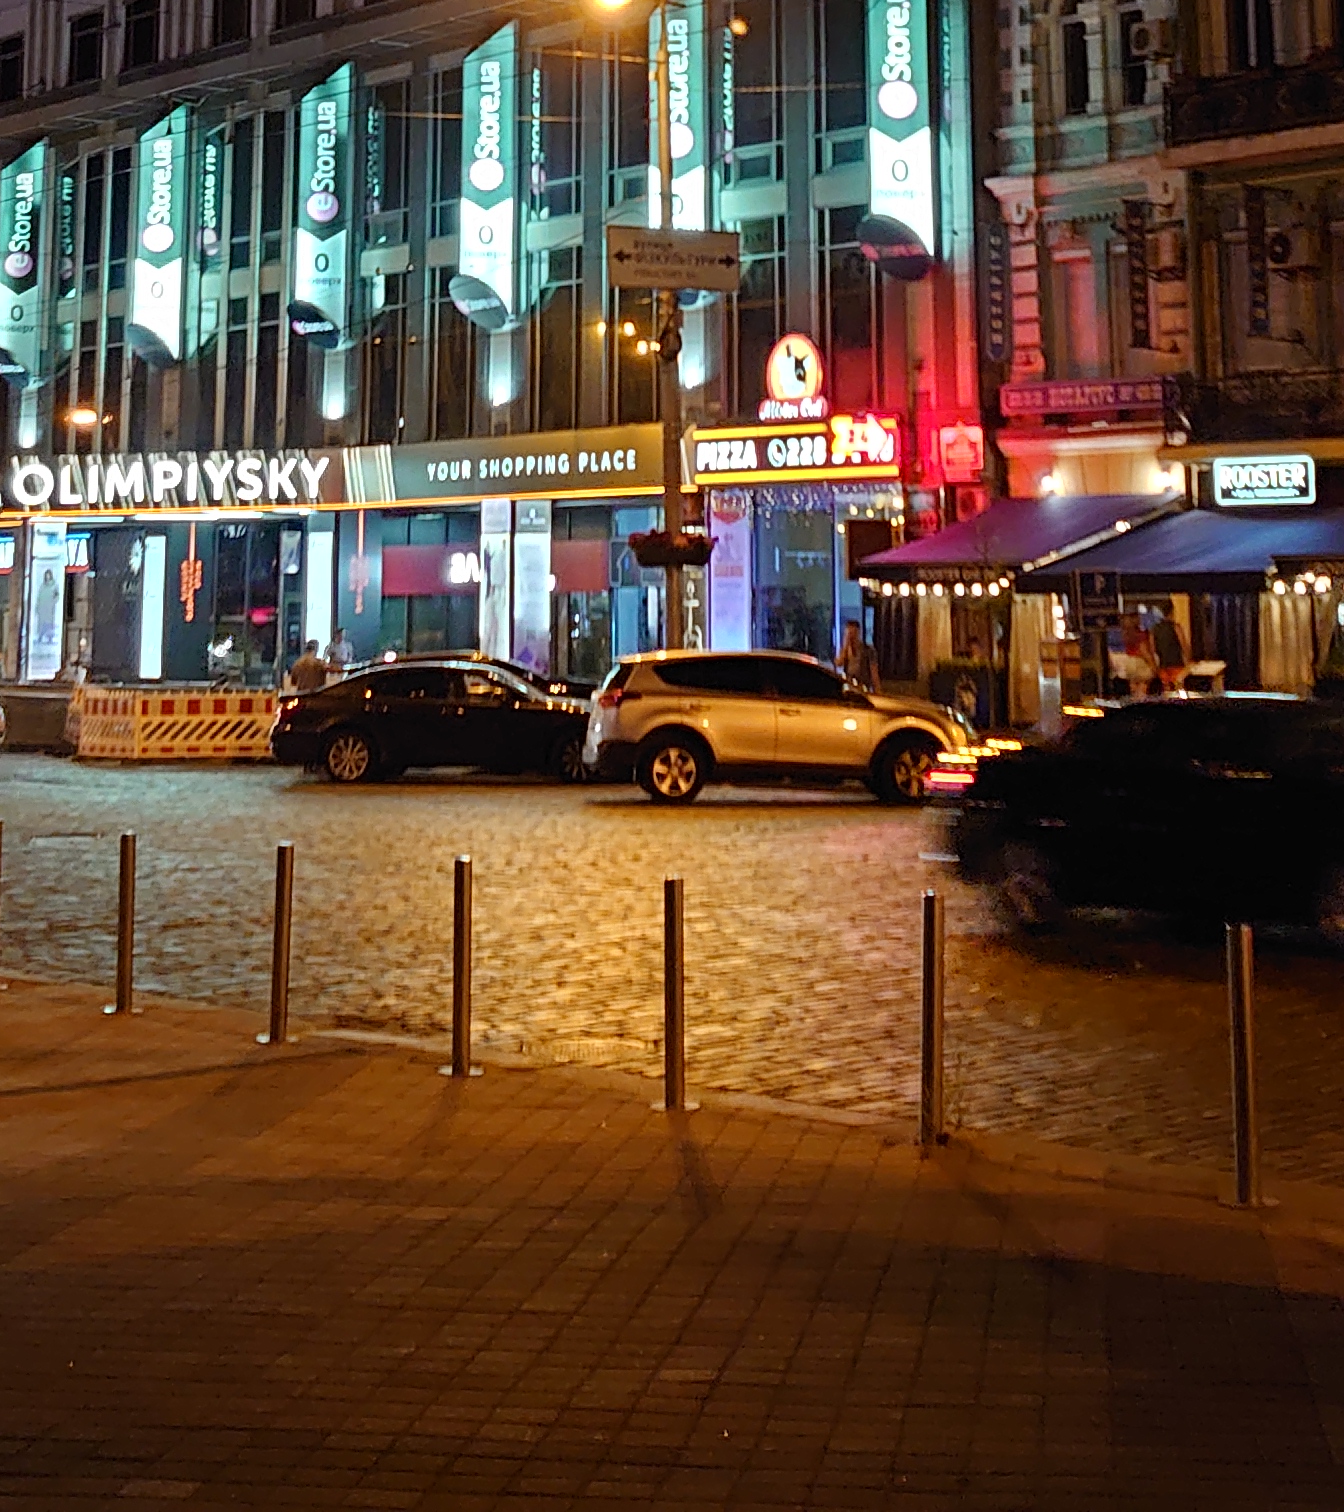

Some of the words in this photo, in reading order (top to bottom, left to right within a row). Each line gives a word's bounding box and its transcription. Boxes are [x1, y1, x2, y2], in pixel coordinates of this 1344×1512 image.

[469, 61, 504, 191] Store.ua
[667, 19, 694, 158] Store.ua
[141, 139, 174, 253] Store.ua
[306, 101, 339, 222] eStore.ua
[4, 172, 34, 277] eStore.ua
[12, 456, 330, 506] OLIMPIYSKY
[427, 458, 472, 482] YOUR
[479, 454, 570, 478] SHOPPING
[578, 449, 637, 473] PLACE
[697, 440, 757, 471] PIZZA
[1220, 463, 1306, 489] ROOSTER
